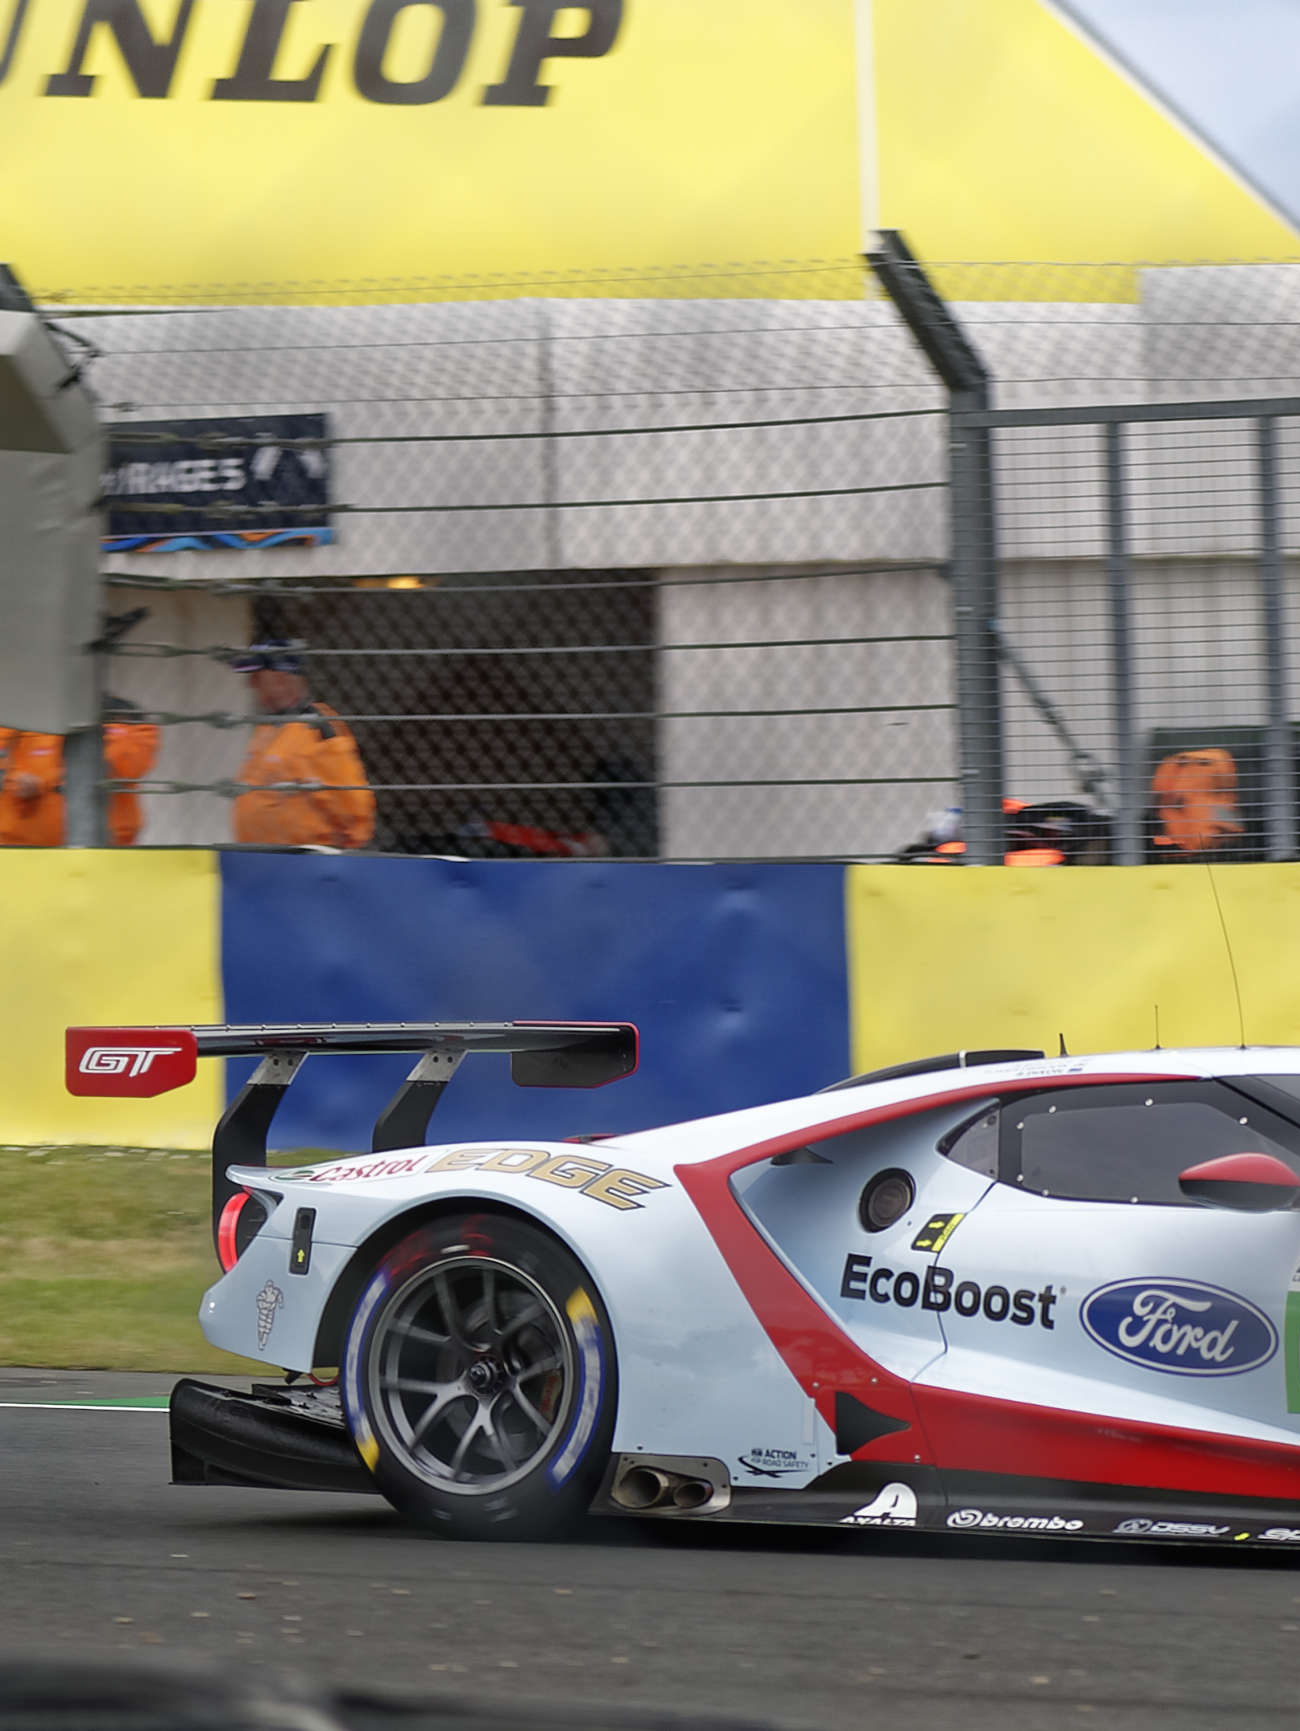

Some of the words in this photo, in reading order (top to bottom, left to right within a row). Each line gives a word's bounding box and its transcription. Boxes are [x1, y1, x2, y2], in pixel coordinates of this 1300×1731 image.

[78, 1047, 183, 1078] GT
[309, 1154, 428, 1183] Castrol
[424, 1147, 674, 1211] EDGE
[839, 1253, 1058, 1331] EcoBoost
[1117, 1288, 1240, 1373] Ford
[979, 1512, 1084, 1531] brembo
